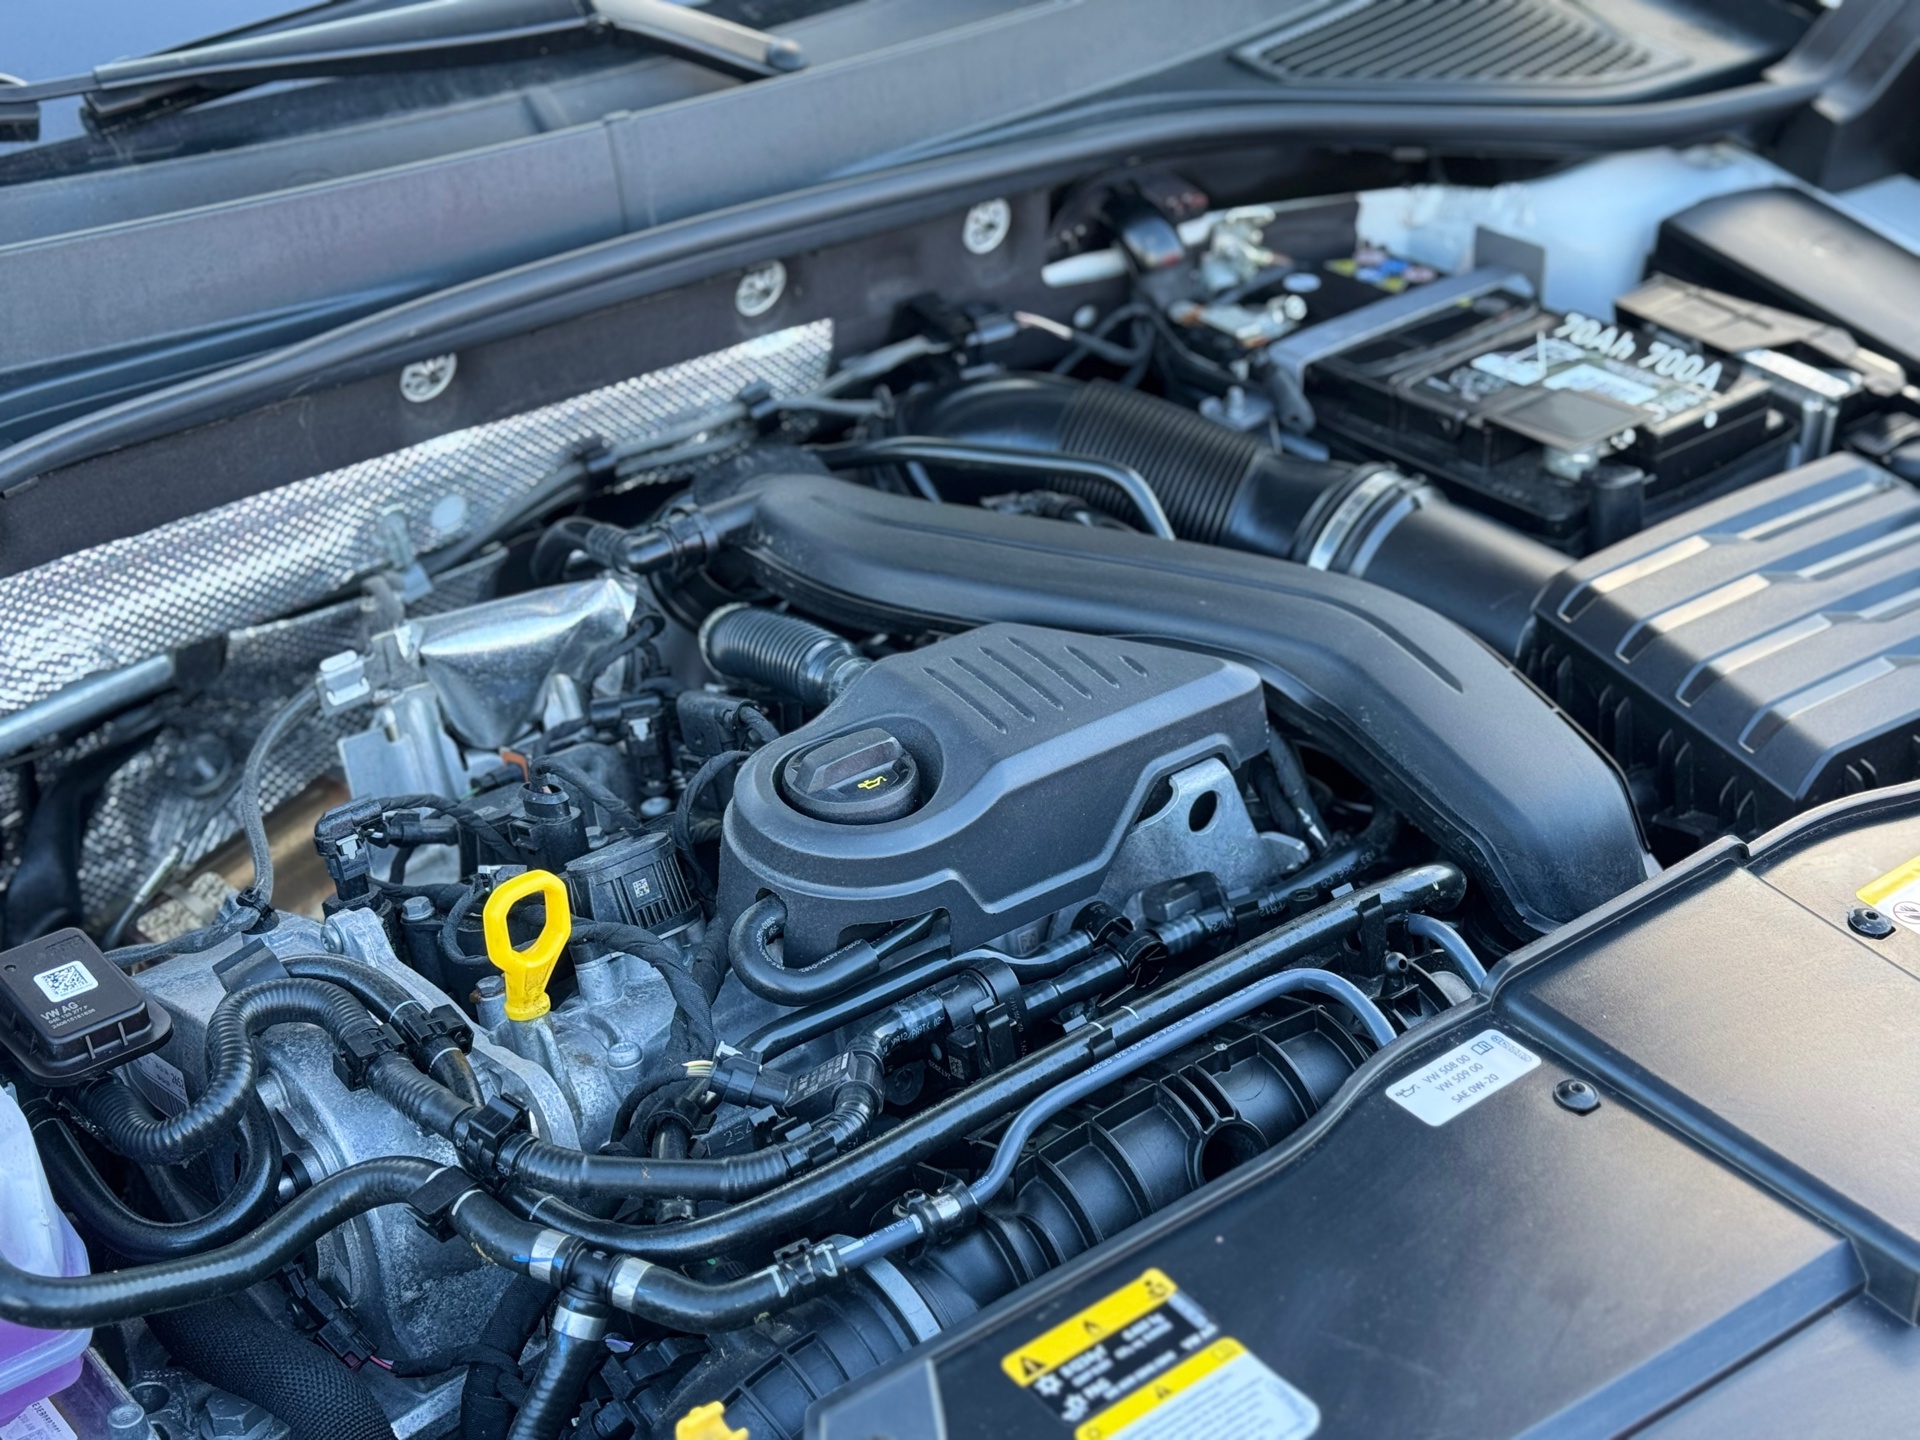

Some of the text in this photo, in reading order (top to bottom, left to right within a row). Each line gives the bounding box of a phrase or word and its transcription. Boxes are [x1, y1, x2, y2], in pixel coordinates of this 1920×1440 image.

[1553, 311, 1637, 361] 70Ah
[1637, 340, 1723, 392] 700A
[40, 1001, 79, 1021] VW AG
[1422, 1054, 1471, 1084] VW 508 00
[1434, 1062, 1484, 1092] VW 509 00
[1451, 1073, 1499, 1104] SAE 0W-20
